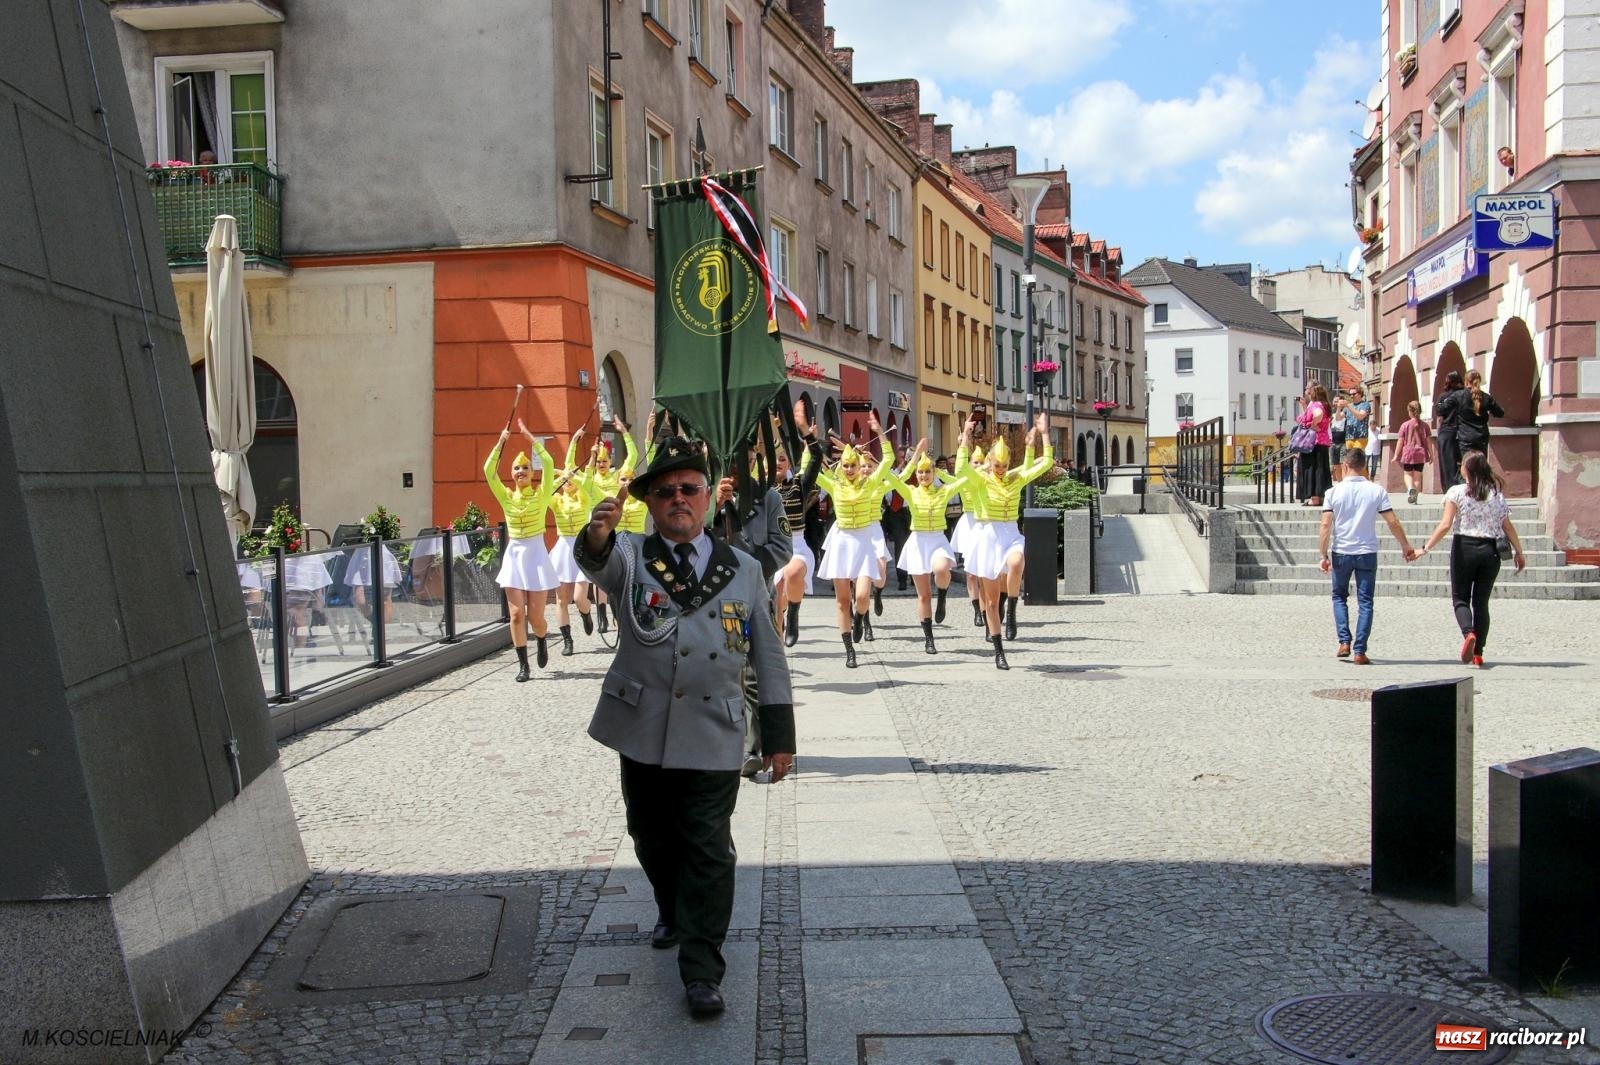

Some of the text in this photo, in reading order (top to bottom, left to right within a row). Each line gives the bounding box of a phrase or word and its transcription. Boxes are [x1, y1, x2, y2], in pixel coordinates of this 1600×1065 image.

[1485, 200, 1546, 212] MAXPOL
[676, 244, 754, 289] RACIBORSKIE KURKOWE
[676, 298, 708, 330] BRACTWO
